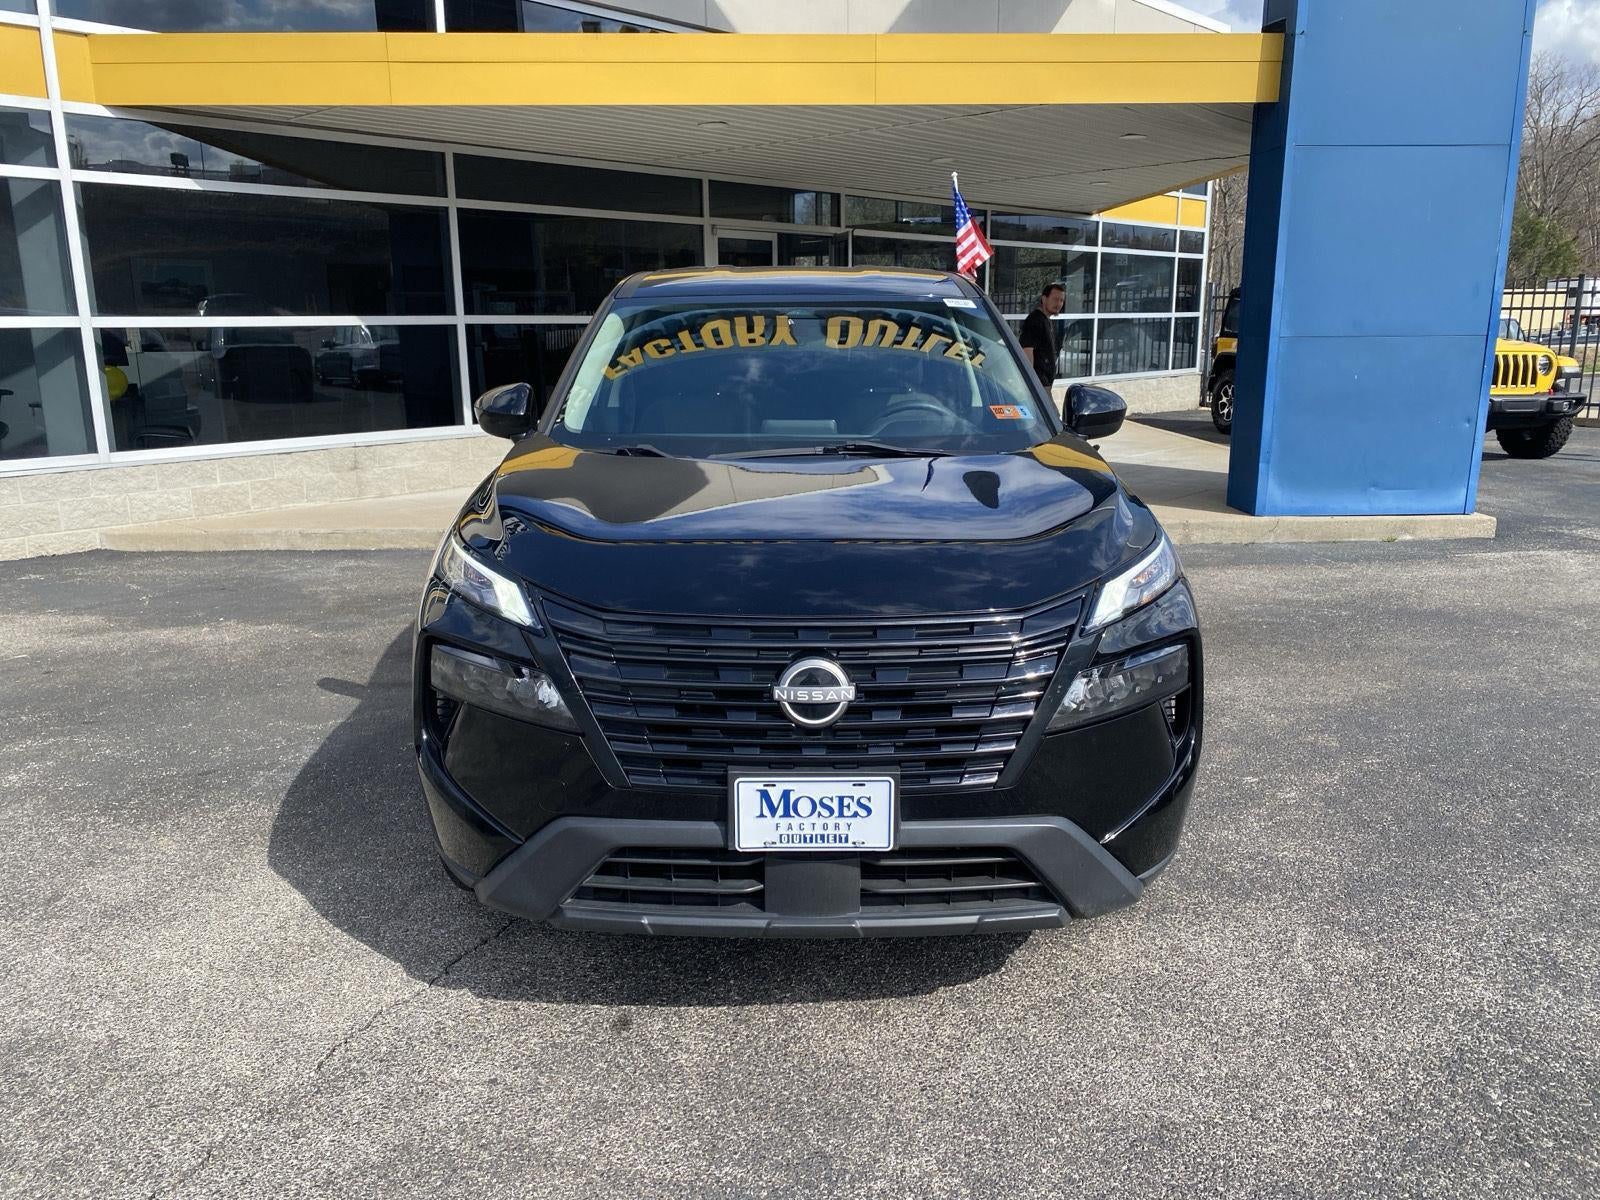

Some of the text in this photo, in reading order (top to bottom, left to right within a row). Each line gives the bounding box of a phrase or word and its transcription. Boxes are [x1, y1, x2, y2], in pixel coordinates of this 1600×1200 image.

[774, 689, 854, 701] NISSAN
[755, 789, 873, 819] MOSES
[775, 822, 853, 831] FACTORY
[779, 833, 849, 844] OUTLET
